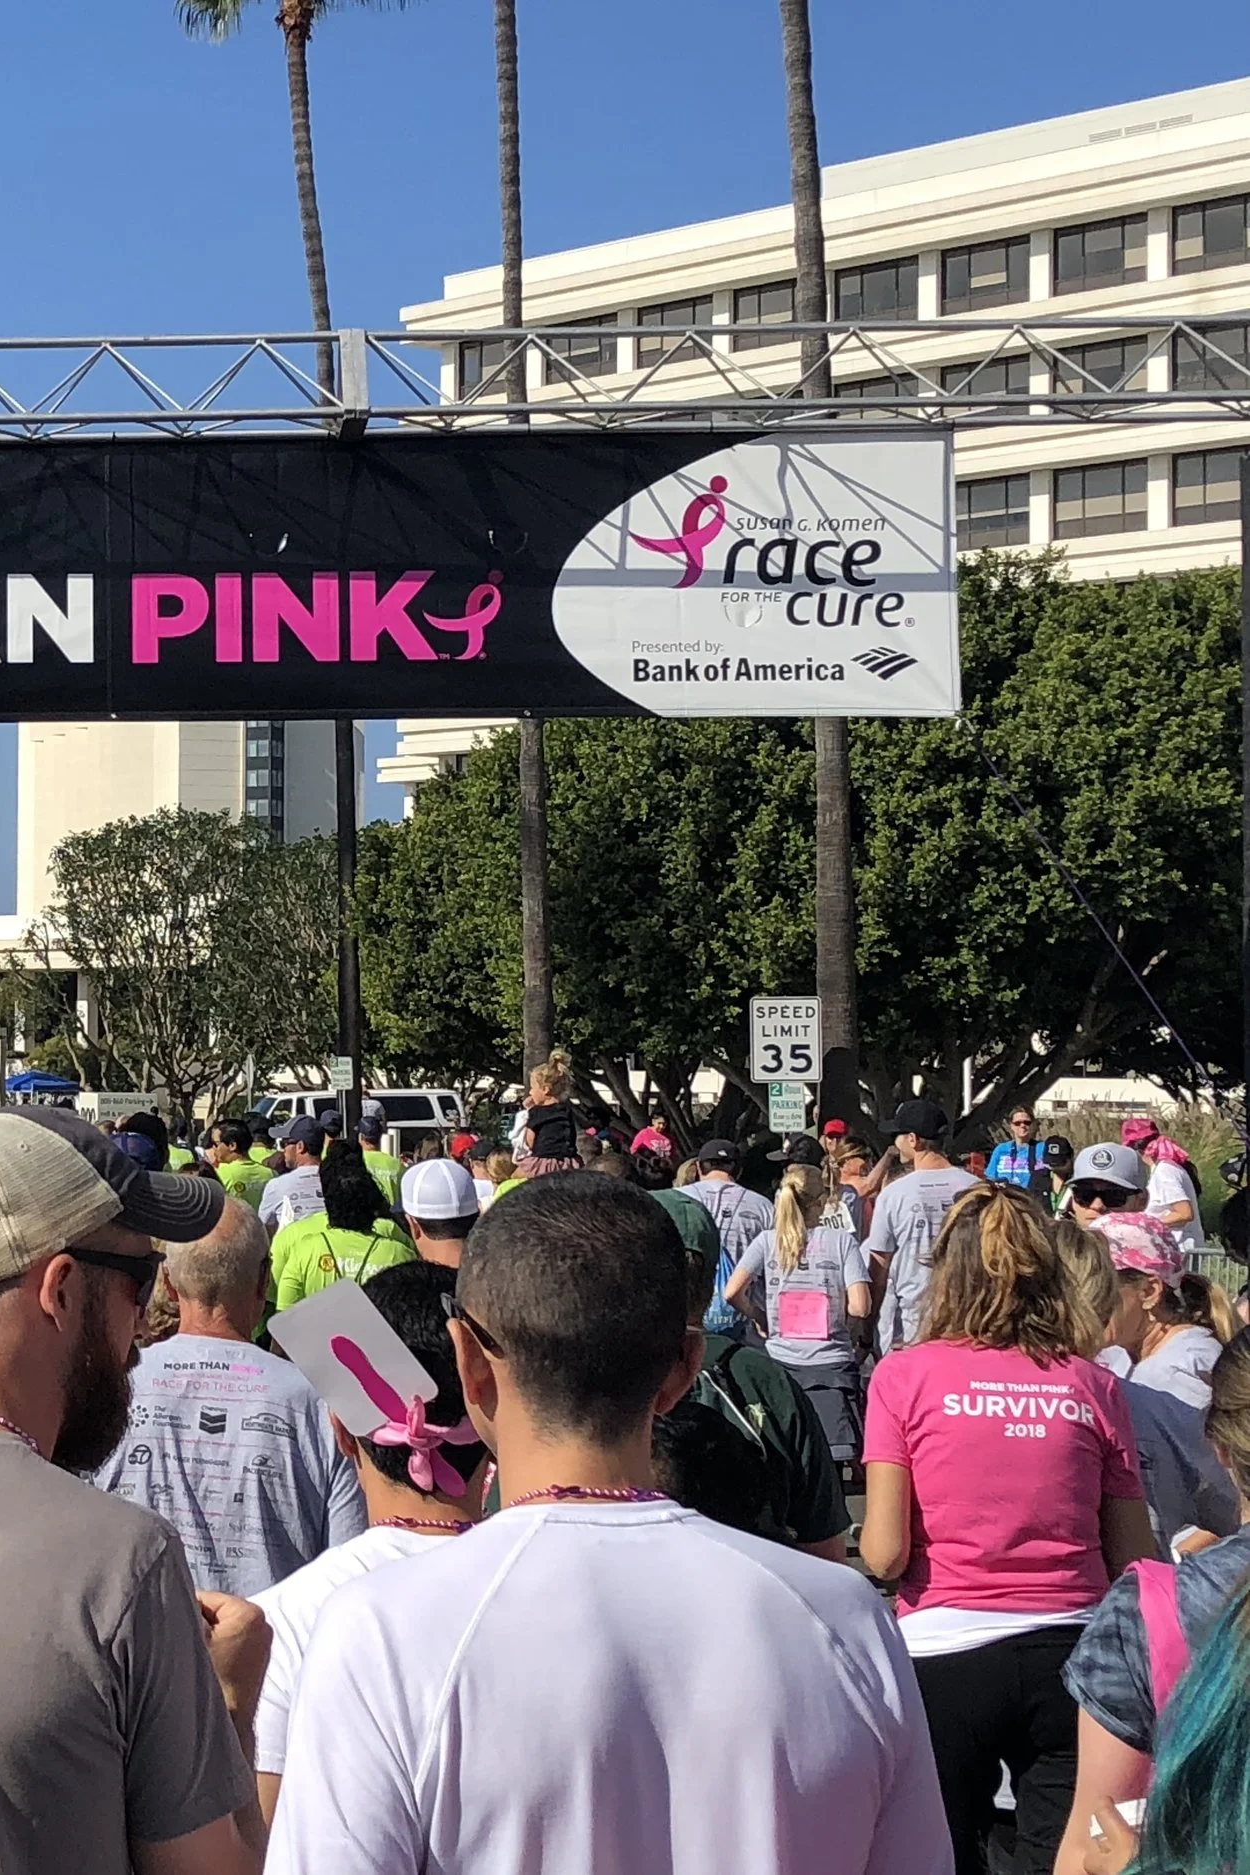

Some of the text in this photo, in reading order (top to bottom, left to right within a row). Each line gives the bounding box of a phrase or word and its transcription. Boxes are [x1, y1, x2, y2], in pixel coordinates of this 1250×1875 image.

[722, 537, 882, 587] race
[720, 591, 783, 603] FOR THE
[131, 570, 439, 664] PINK
[786, 591, 905, 628] cure
[631, 640, 724, 655] Presented by:
[632, 658, 845, 683] Bank of America
[756, 1006, 816, 1019] SPEED
[762, 1025, 811, 1037] LIMIT
[760, 1044, 813, 1074] 35
[771, 1083, 780, 1095] 2
[163, 1361, 196, 1371] MORE
[199, 1361, 230, 1371] THAN
[970, 1380, 1005, 1392] MORE
[1006, 1382, 1039, 1393] THAN
[943, 1393, 1096, 1426] SURVIVOR
[1004, 1423, 1047, 1438] 2018
